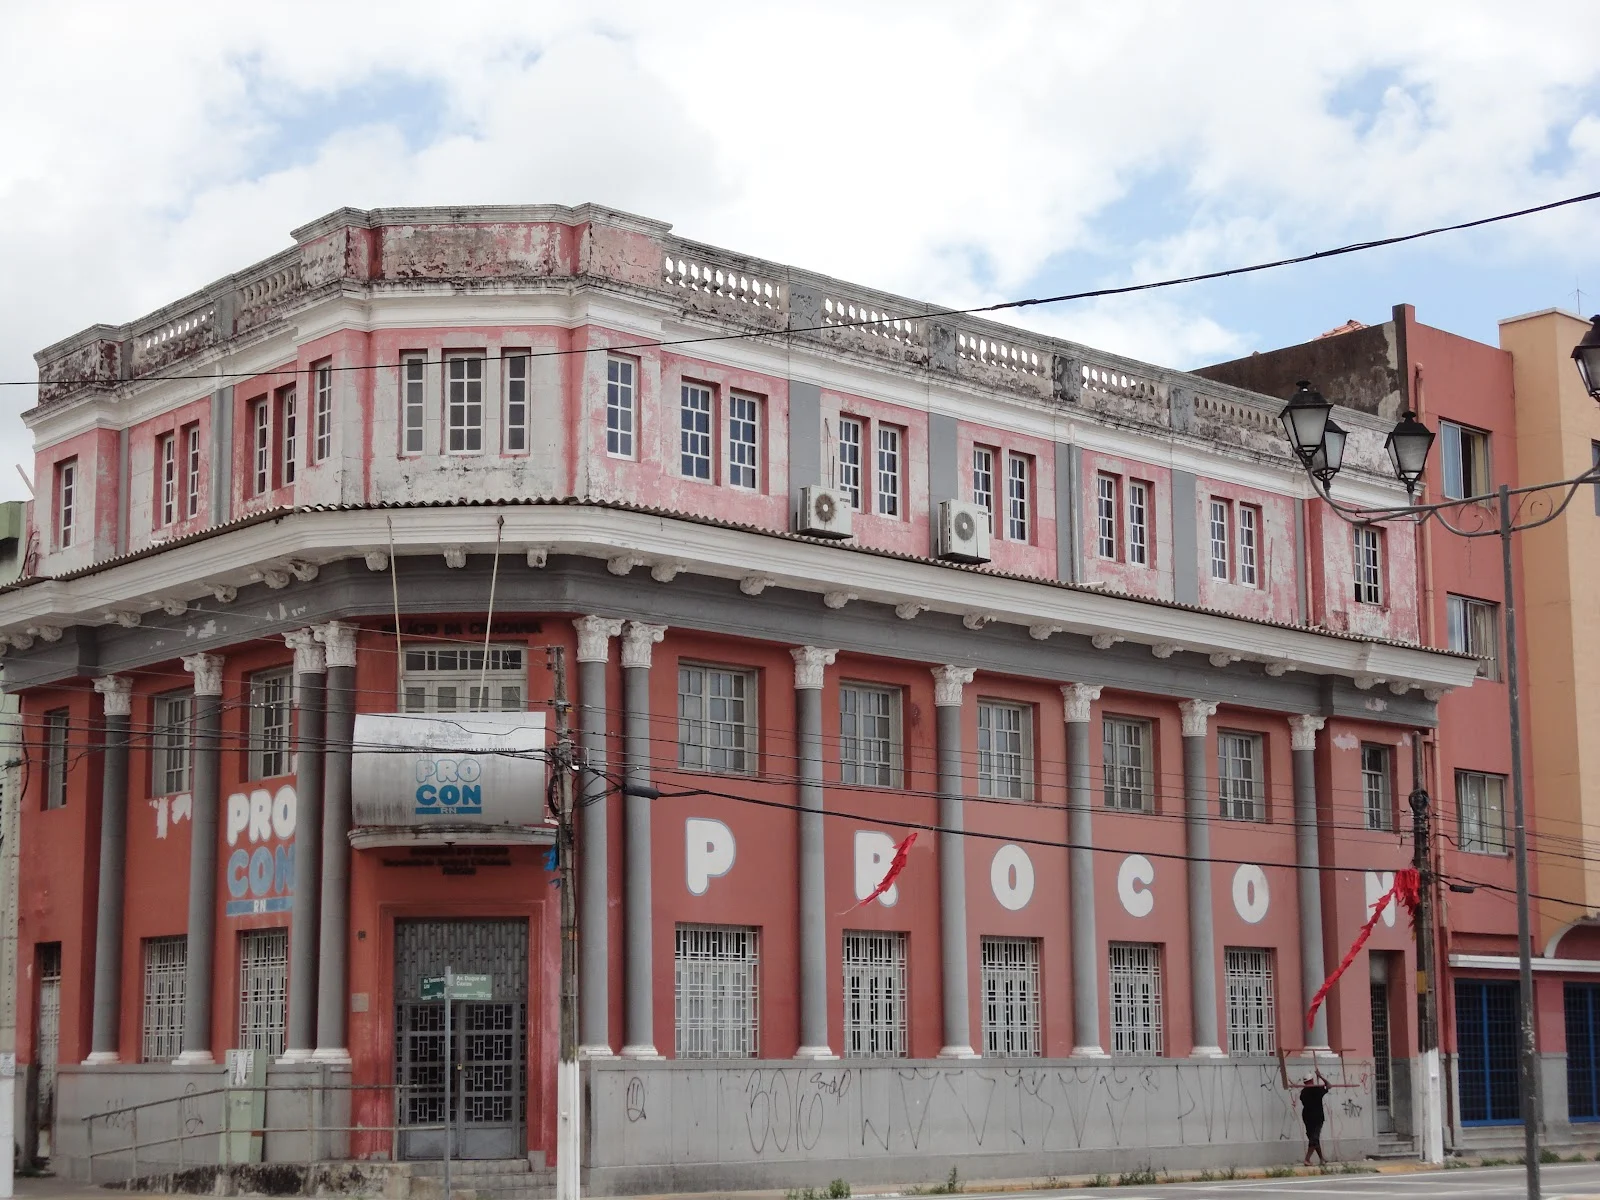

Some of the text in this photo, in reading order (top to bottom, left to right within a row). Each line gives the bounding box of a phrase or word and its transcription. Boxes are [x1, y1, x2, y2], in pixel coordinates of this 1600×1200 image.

[415, 758, 481, 783] PRO
[415, 784, 481, 805] CON
[227, 784, 297, 846] PRO
[227, 844, 296, 898] CON
[253, 899, 266, 913] RN
